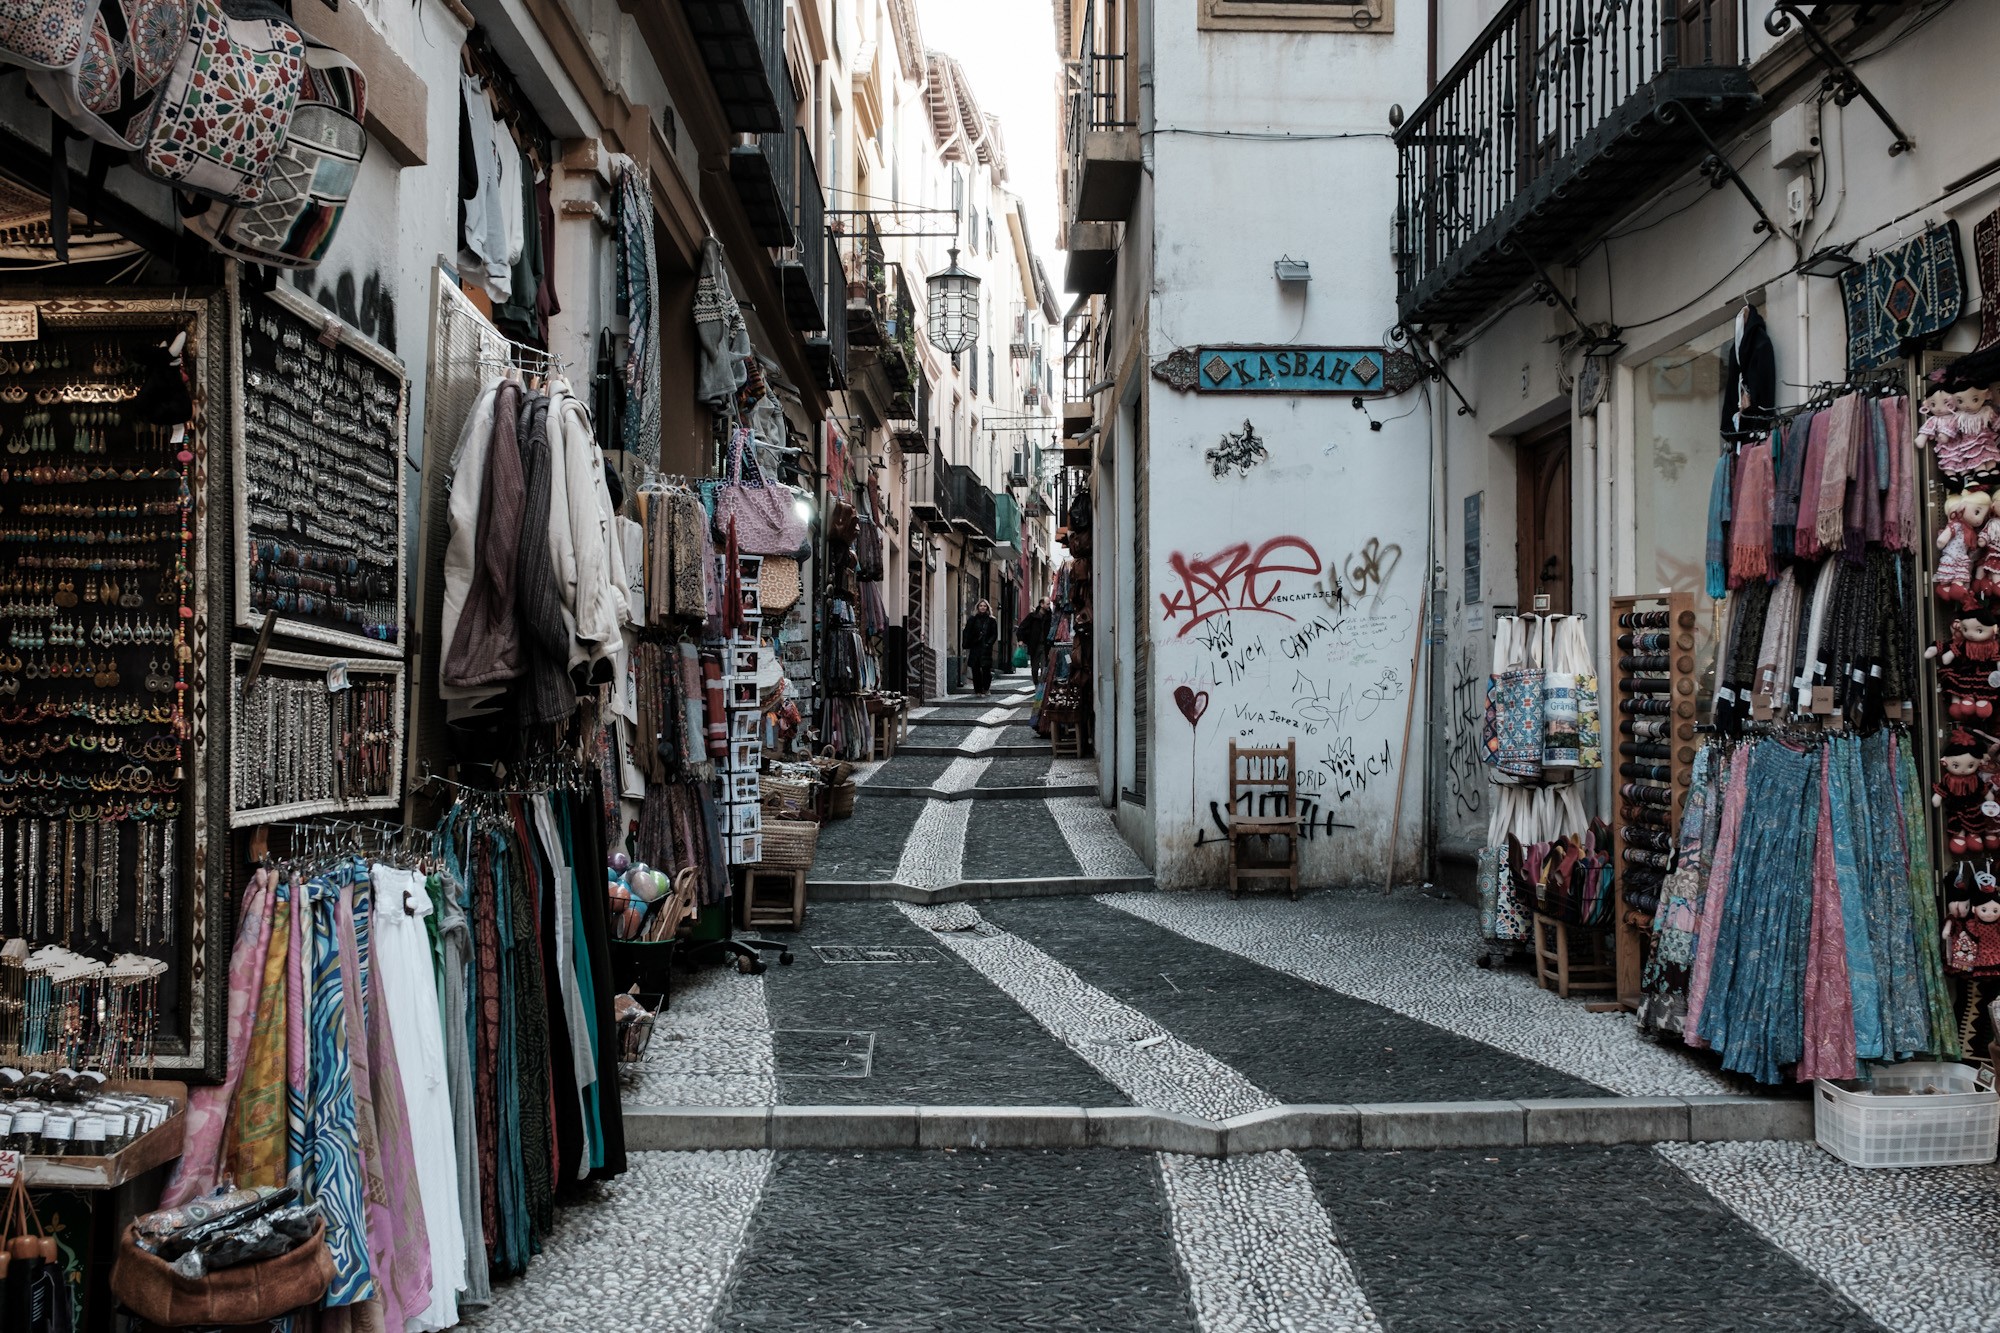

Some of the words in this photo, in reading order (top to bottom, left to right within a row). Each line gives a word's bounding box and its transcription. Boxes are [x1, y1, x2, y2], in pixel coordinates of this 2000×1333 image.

[1232, 352, 1351, 385] KASBAH
[1234, 702, 1265, 724] VIVA
[1268, 710, 1299, 728] Jerez
